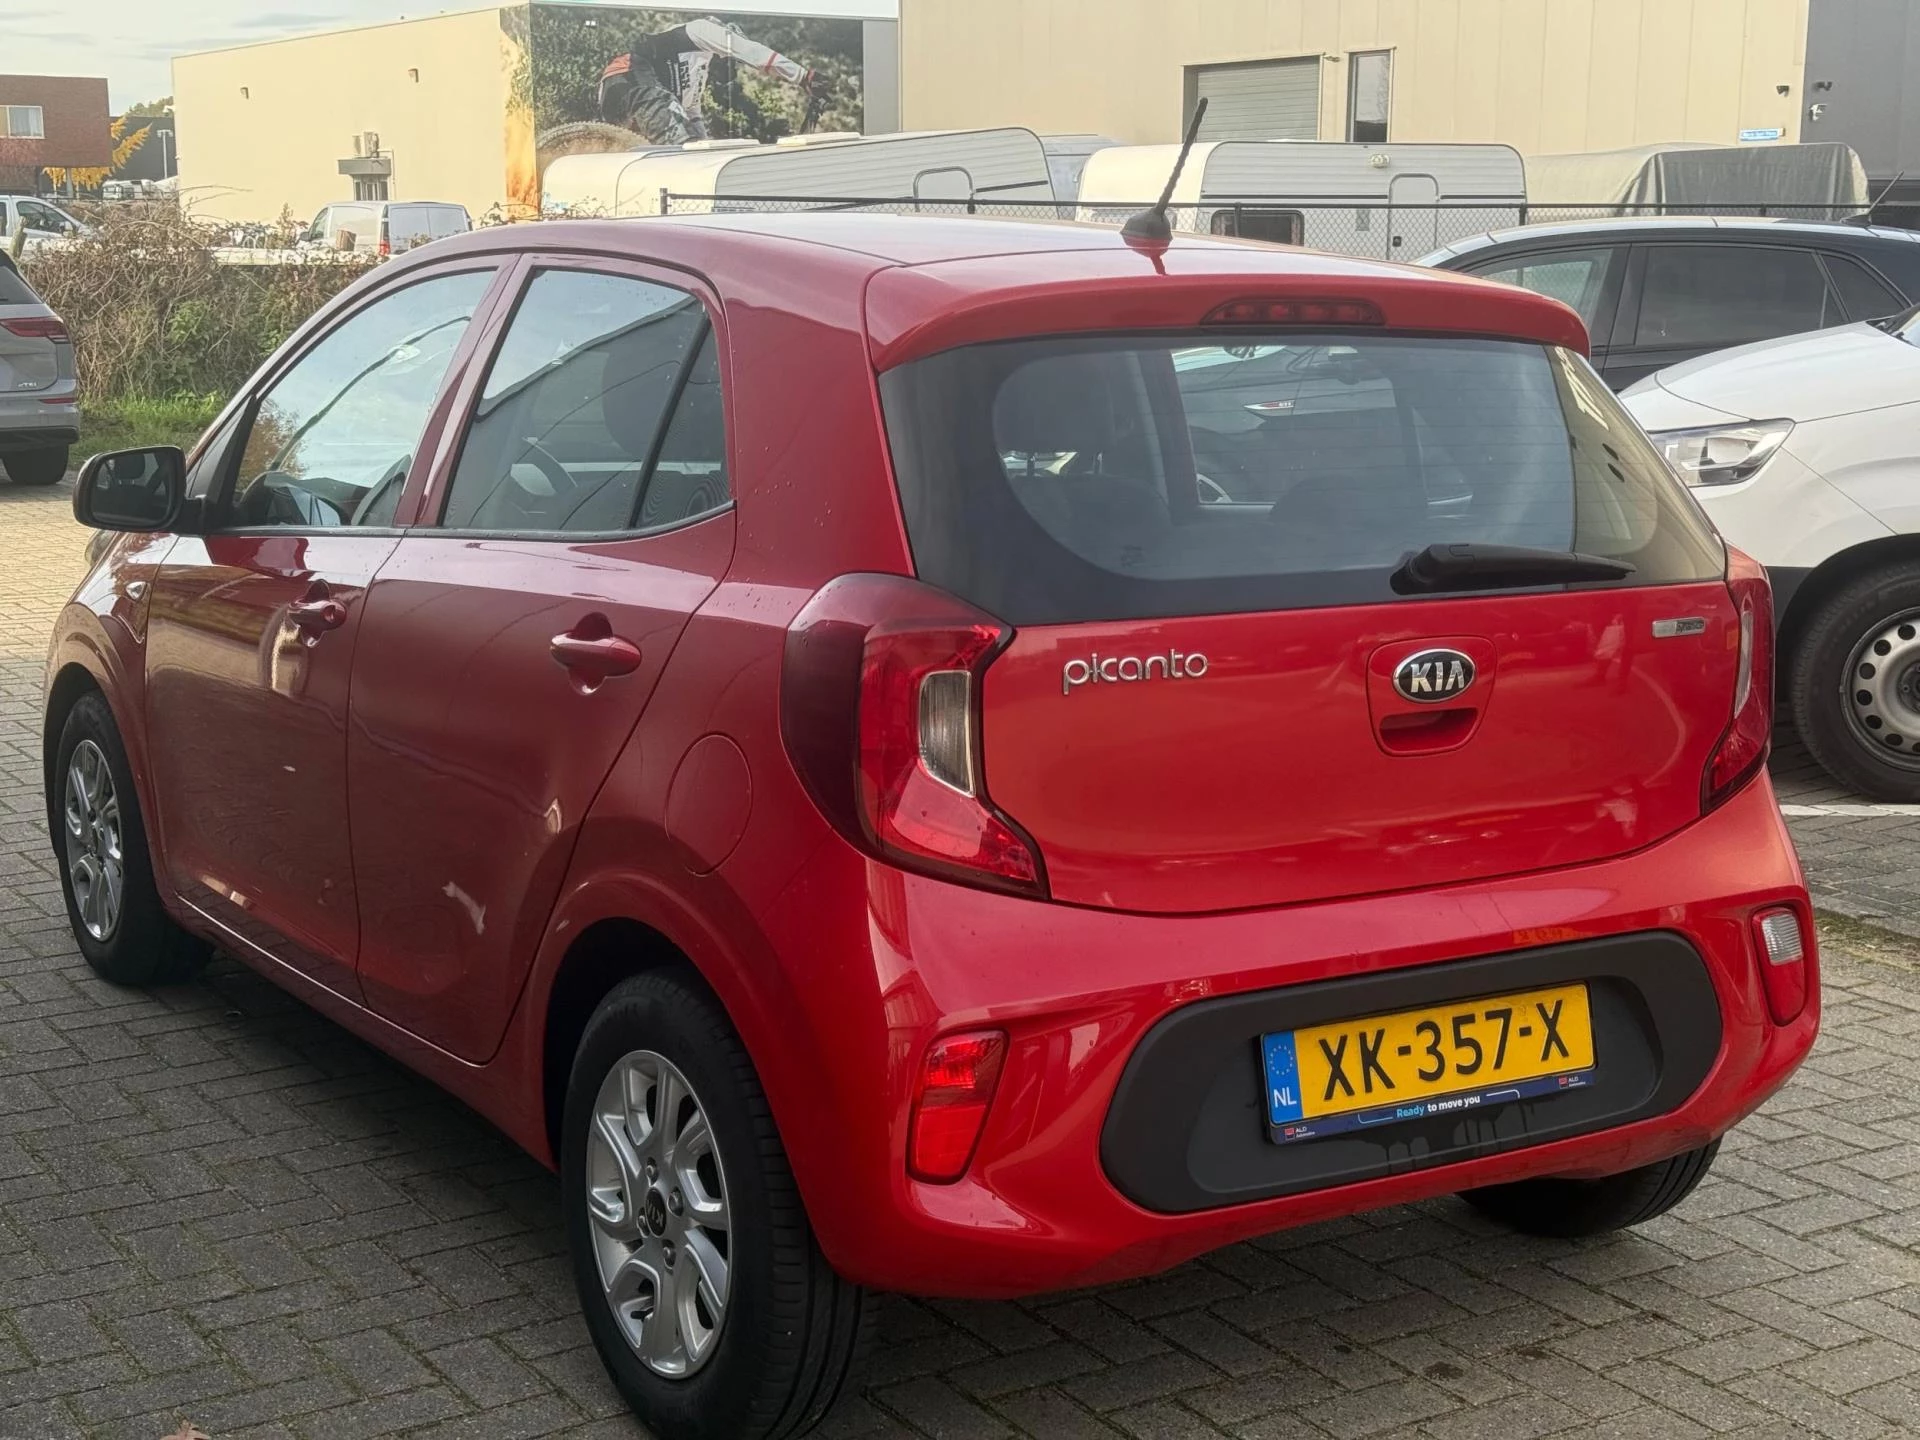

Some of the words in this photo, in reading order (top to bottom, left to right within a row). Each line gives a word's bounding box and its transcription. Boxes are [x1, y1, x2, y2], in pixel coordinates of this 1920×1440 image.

[1063, 648, 1208, 695] picanto
[1410, 660, 1465, 693] KIA
[1318, 1000, 1570, 1102] XK-357-X
[1273, 1086, 1297, 1108] NL
[1396, 1106, 1425, 1118] Ready
[1427, 1103, 1437, 1112] to
[1438, 1099, 1463, 1110] move
[1464, 1095, 1481, 1107] you
